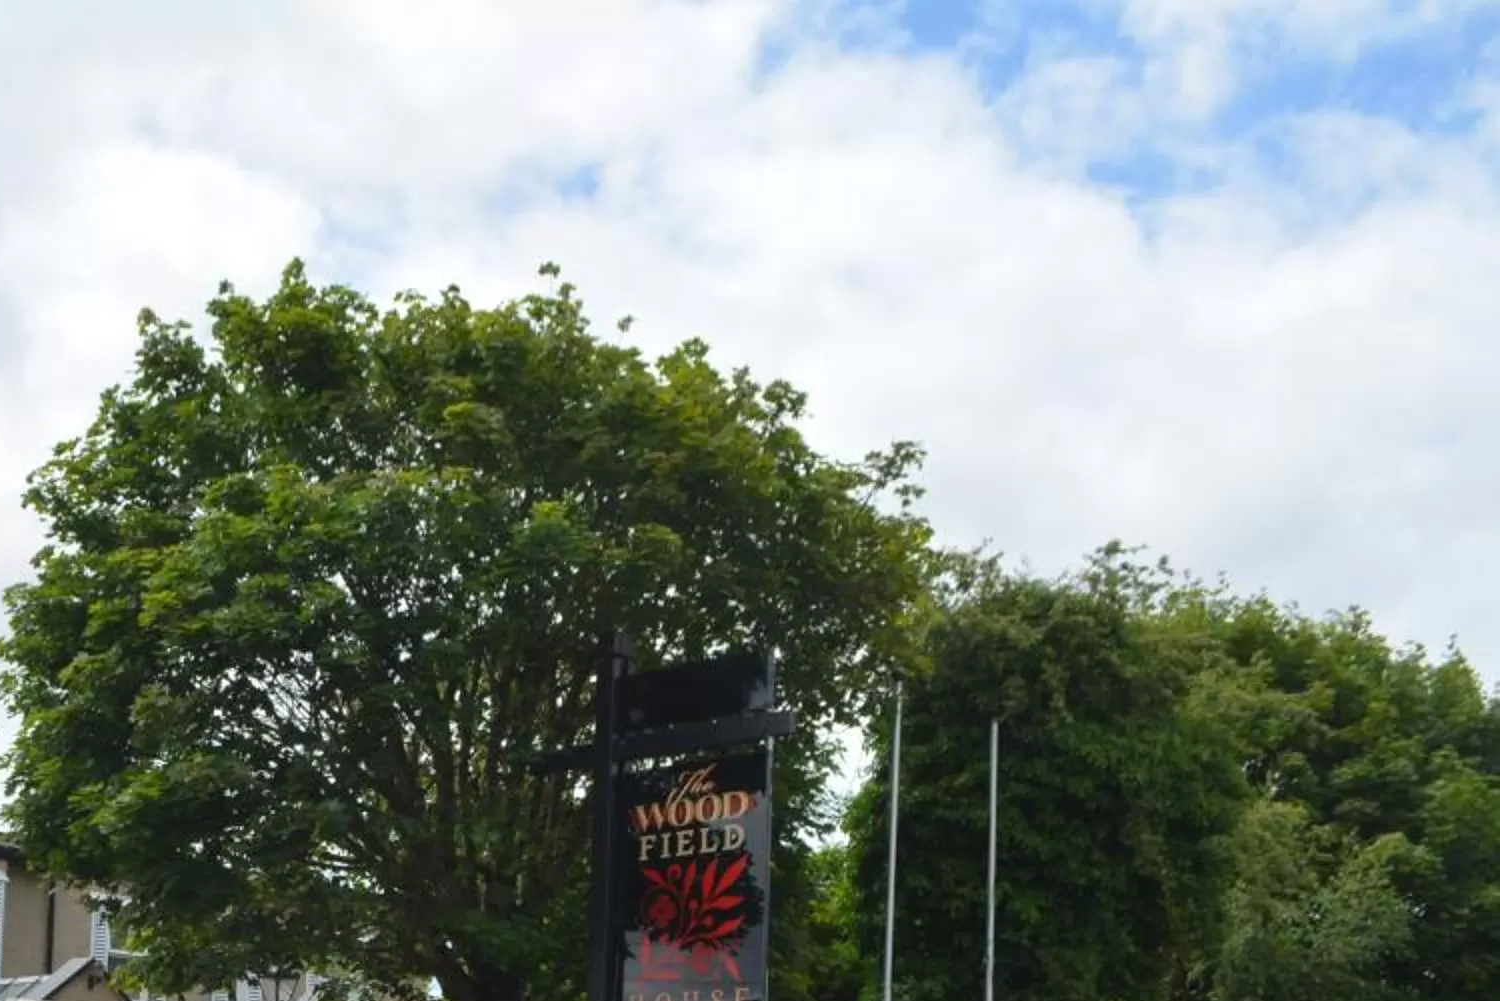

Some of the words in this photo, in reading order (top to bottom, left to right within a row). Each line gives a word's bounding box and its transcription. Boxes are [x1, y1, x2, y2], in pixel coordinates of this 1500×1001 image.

[668, 763, 718, 806] The
[634, 791, 750, 832] WOOD
[638, 823, 746, 862] FIELD
